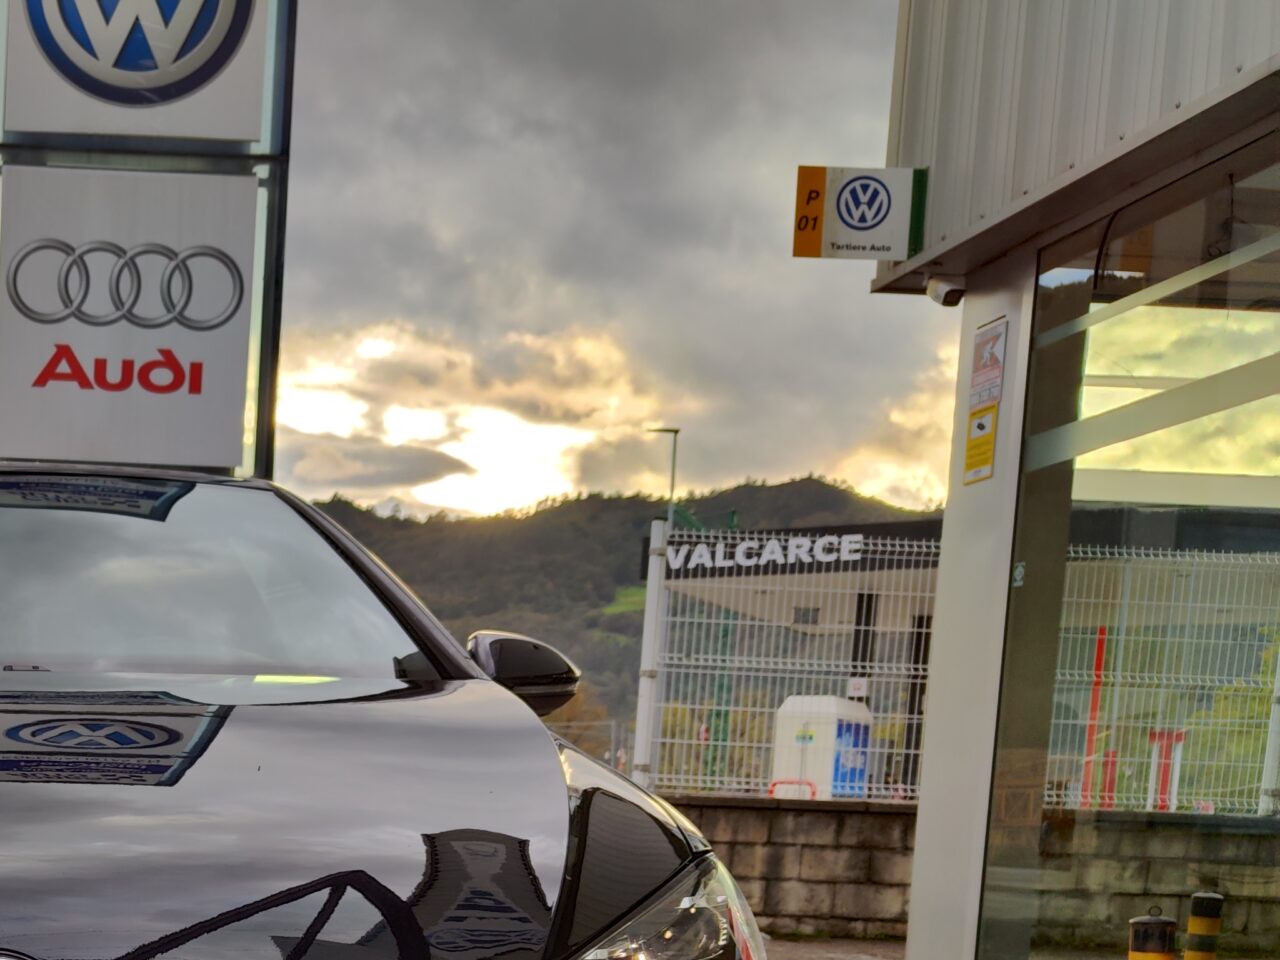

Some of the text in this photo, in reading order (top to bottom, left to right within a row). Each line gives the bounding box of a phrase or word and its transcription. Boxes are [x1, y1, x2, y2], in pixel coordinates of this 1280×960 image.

[806, 190, 820, 205] P
[797, 215, 819, 231] 01
[830, 242, 892, 252] Tartiere Auto
[32, 344, 203, 395] Audi
[666, 534, 864, 570] VALCARCE
